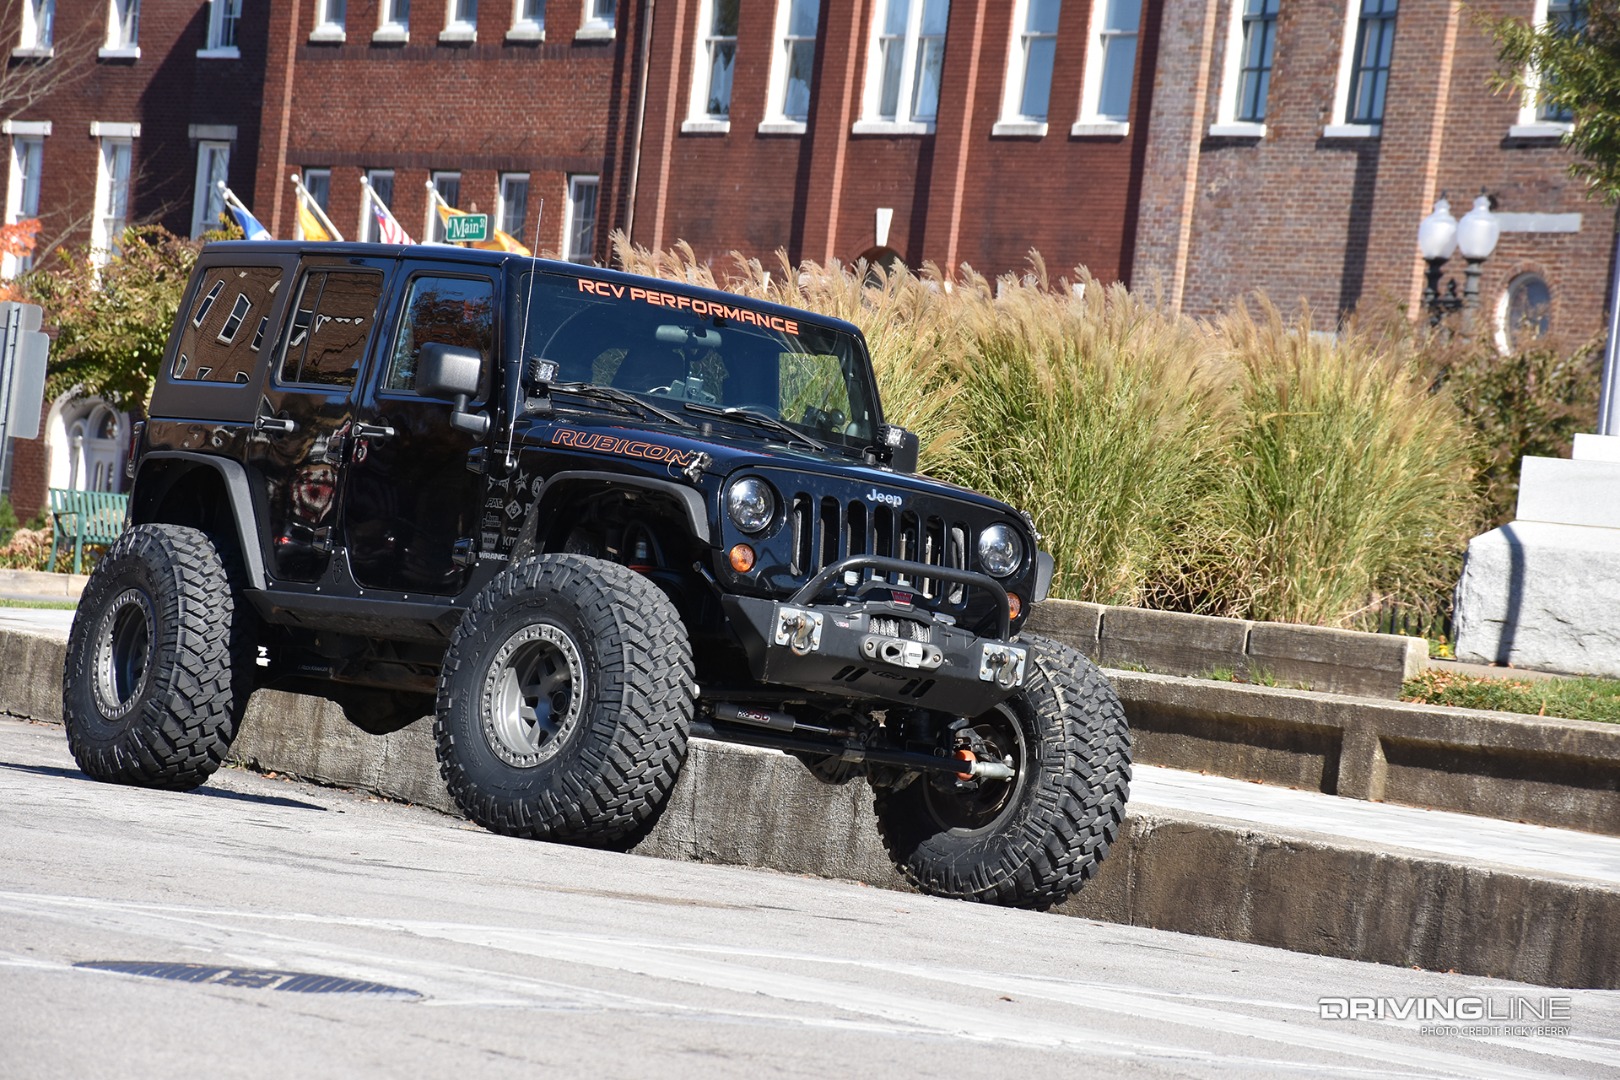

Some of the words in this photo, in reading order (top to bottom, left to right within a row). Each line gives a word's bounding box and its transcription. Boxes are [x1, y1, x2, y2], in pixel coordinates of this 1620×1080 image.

[451, 218, 479, 238] Main
[577, 278, 625, 299] RCV
[630, 287, 800, 335] PERFORMANCE
[552, 428, 692, 467] RUBICON
[866, 488, 903, 508] Jeep
[478, 552, 509, 561] WRANGL
